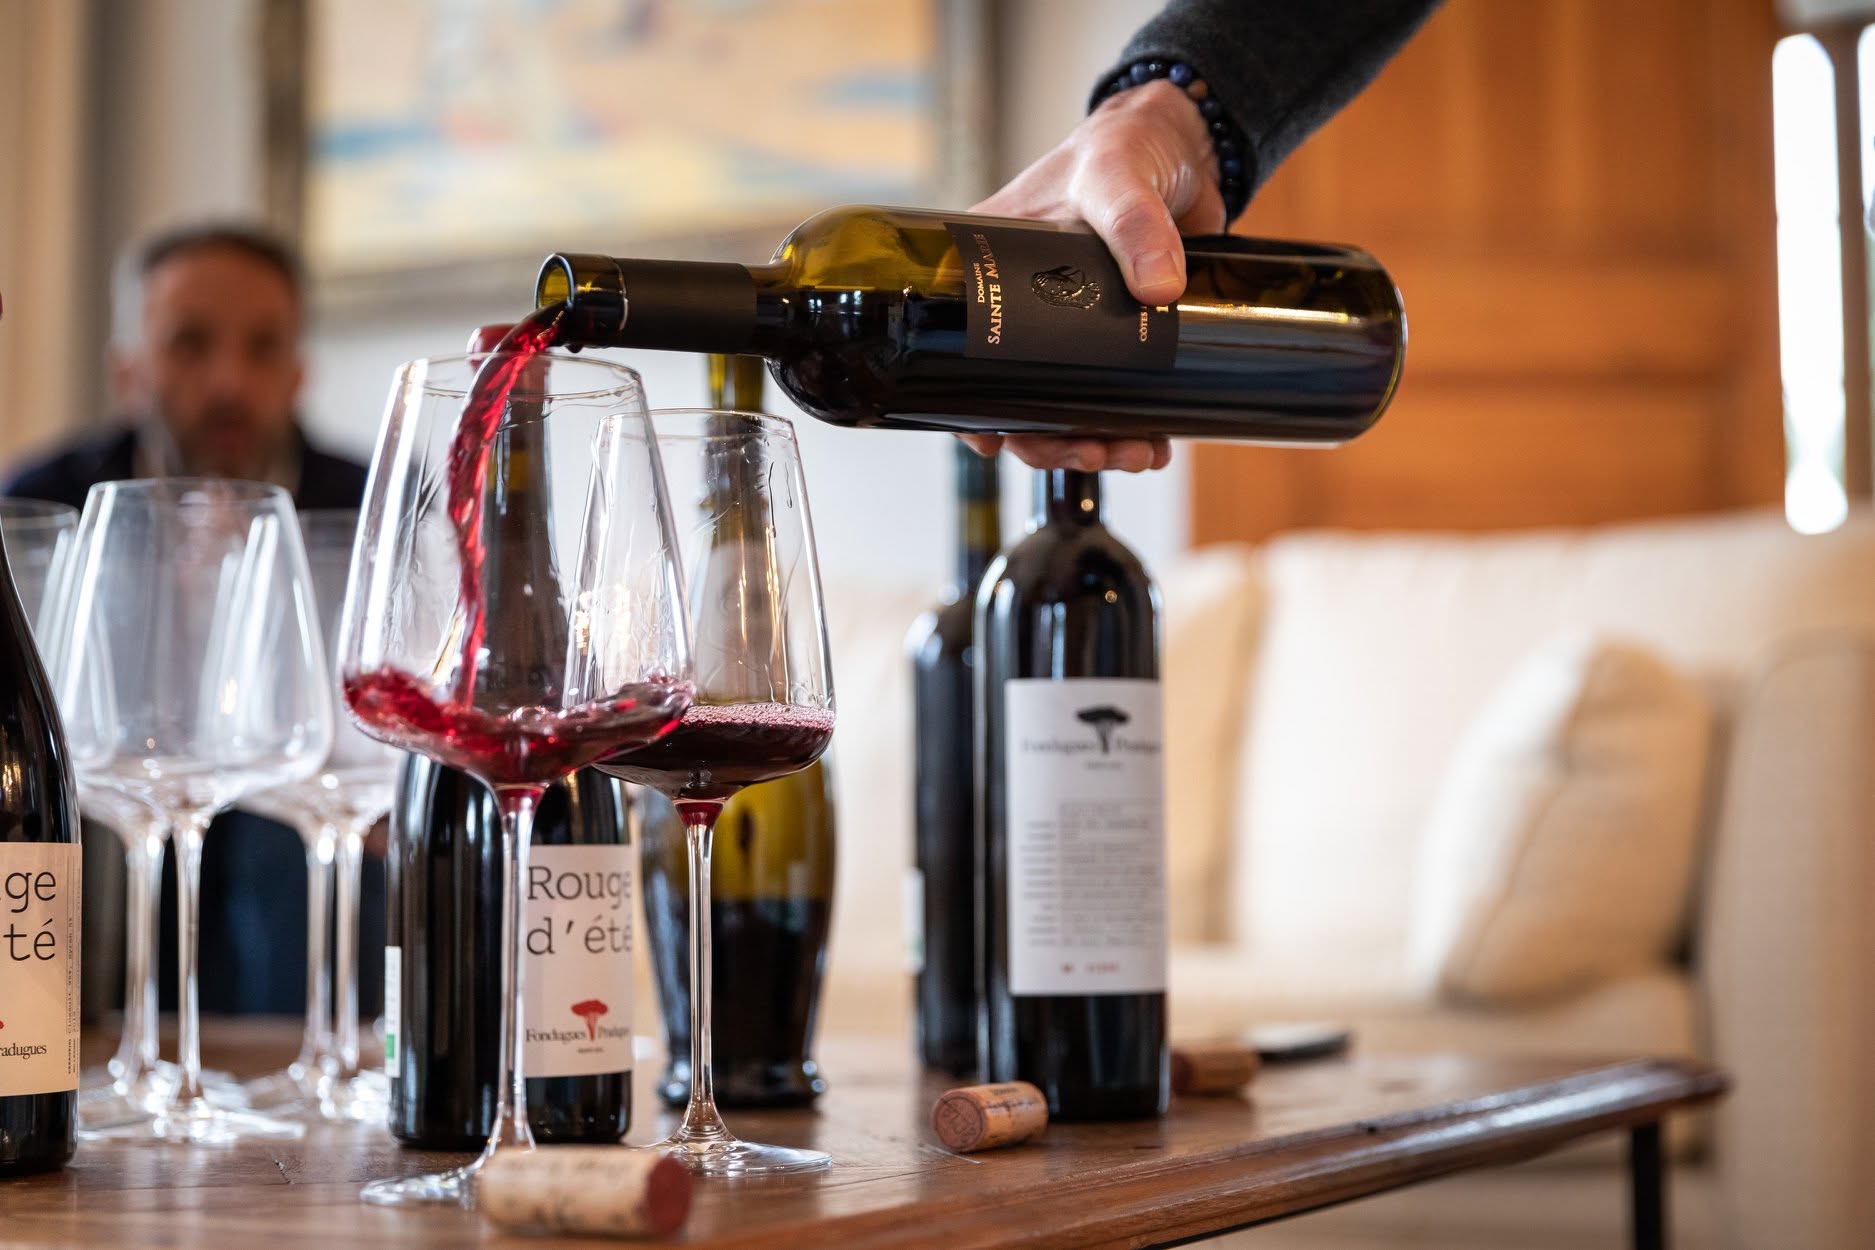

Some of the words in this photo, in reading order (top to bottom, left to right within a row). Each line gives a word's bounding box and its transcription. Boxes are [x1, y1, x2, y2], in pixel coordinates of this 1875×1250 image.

[972, 262, 986, 303] DOMAINE
[987, 283, 1002, 345] SAINTE
[527, 866, 632, 910] Rouge
